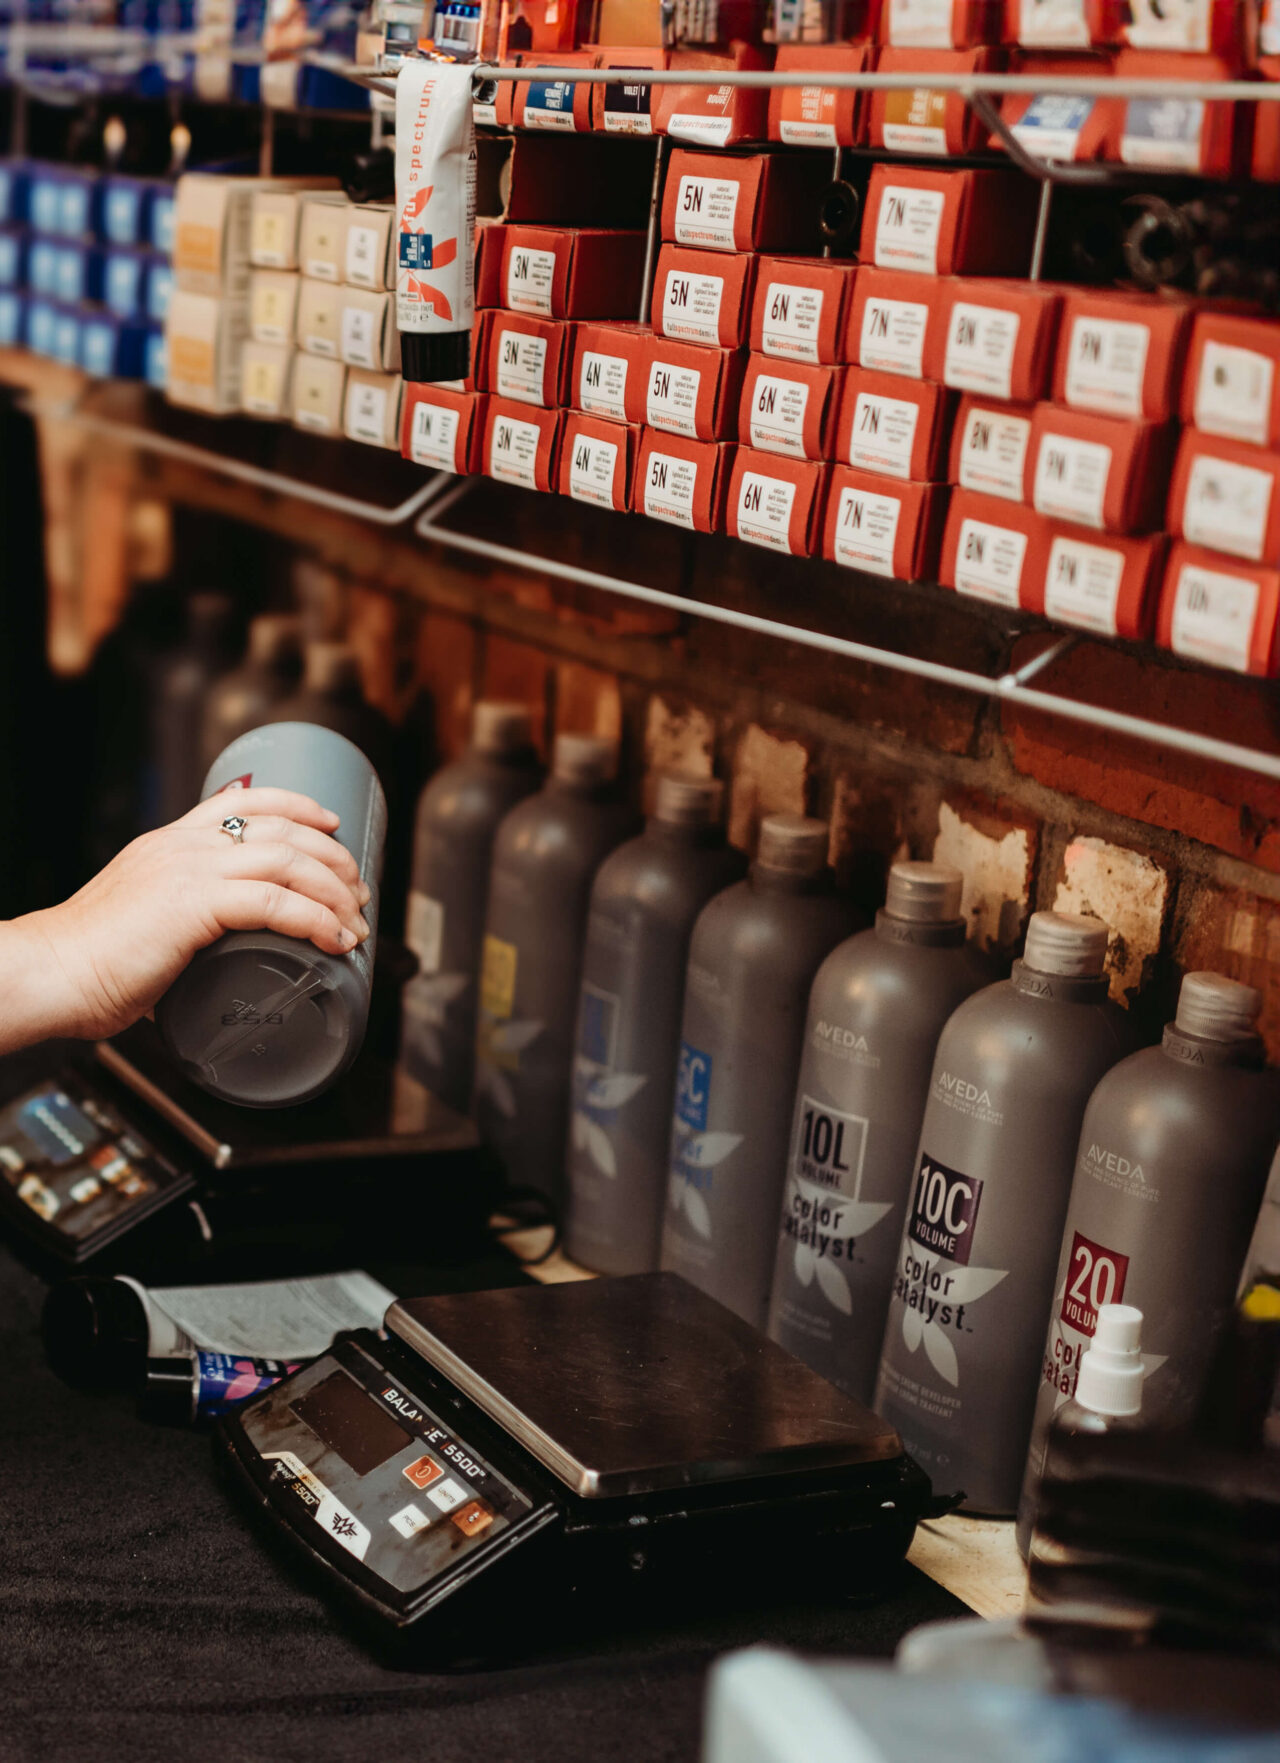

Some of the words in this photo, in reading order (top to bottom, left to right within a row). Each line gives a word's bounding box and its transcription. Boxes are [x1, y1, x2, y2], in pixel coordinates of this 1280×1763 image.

[683, 185, 704, 213] 5N
[885, 196, 907, 228] 7N
[514, 254, 530, 280] 3N
[670, 279, 690, 308] 5N
[771, 293, 790, 323] 6N
[869, 307, 891, 338] 7N
[503, 340, 519, 366] 3N
[585, 361, 602, 388] 4N
[653, 370, 671, 399] 5N
[758, 384, 777, 415] 6N
[860, 404, 882, 435] 7N
[496, 425, 513, 451] 3N
[574, 445, 591, 473] 4N
[651, 461, 669, 490] 5N
[743, 482, 763, 513] 6N
[843, 499, 865, 530] 7N
[815, 1020, 869, 1051] AVEDA
[938, 1071, 992, 1107] AVEDA
[802, 1109, 849, 1172] 10L
[1087, 1143, 1146, 1183] AVEDA
[793, 1193, 844, 1231] color
[916, 1165, 973, 1236] 10C
[784, 1214, 857, 1261] atalyst
[915, 1221, 957, 1254] VOLUME
[904, 1255, 955, 1296] color
[1069, 1245, 1116, 1311] 20
[894, 1277, 966, 1331] atalyst
[1055, 1338, 1082, 1372] col
